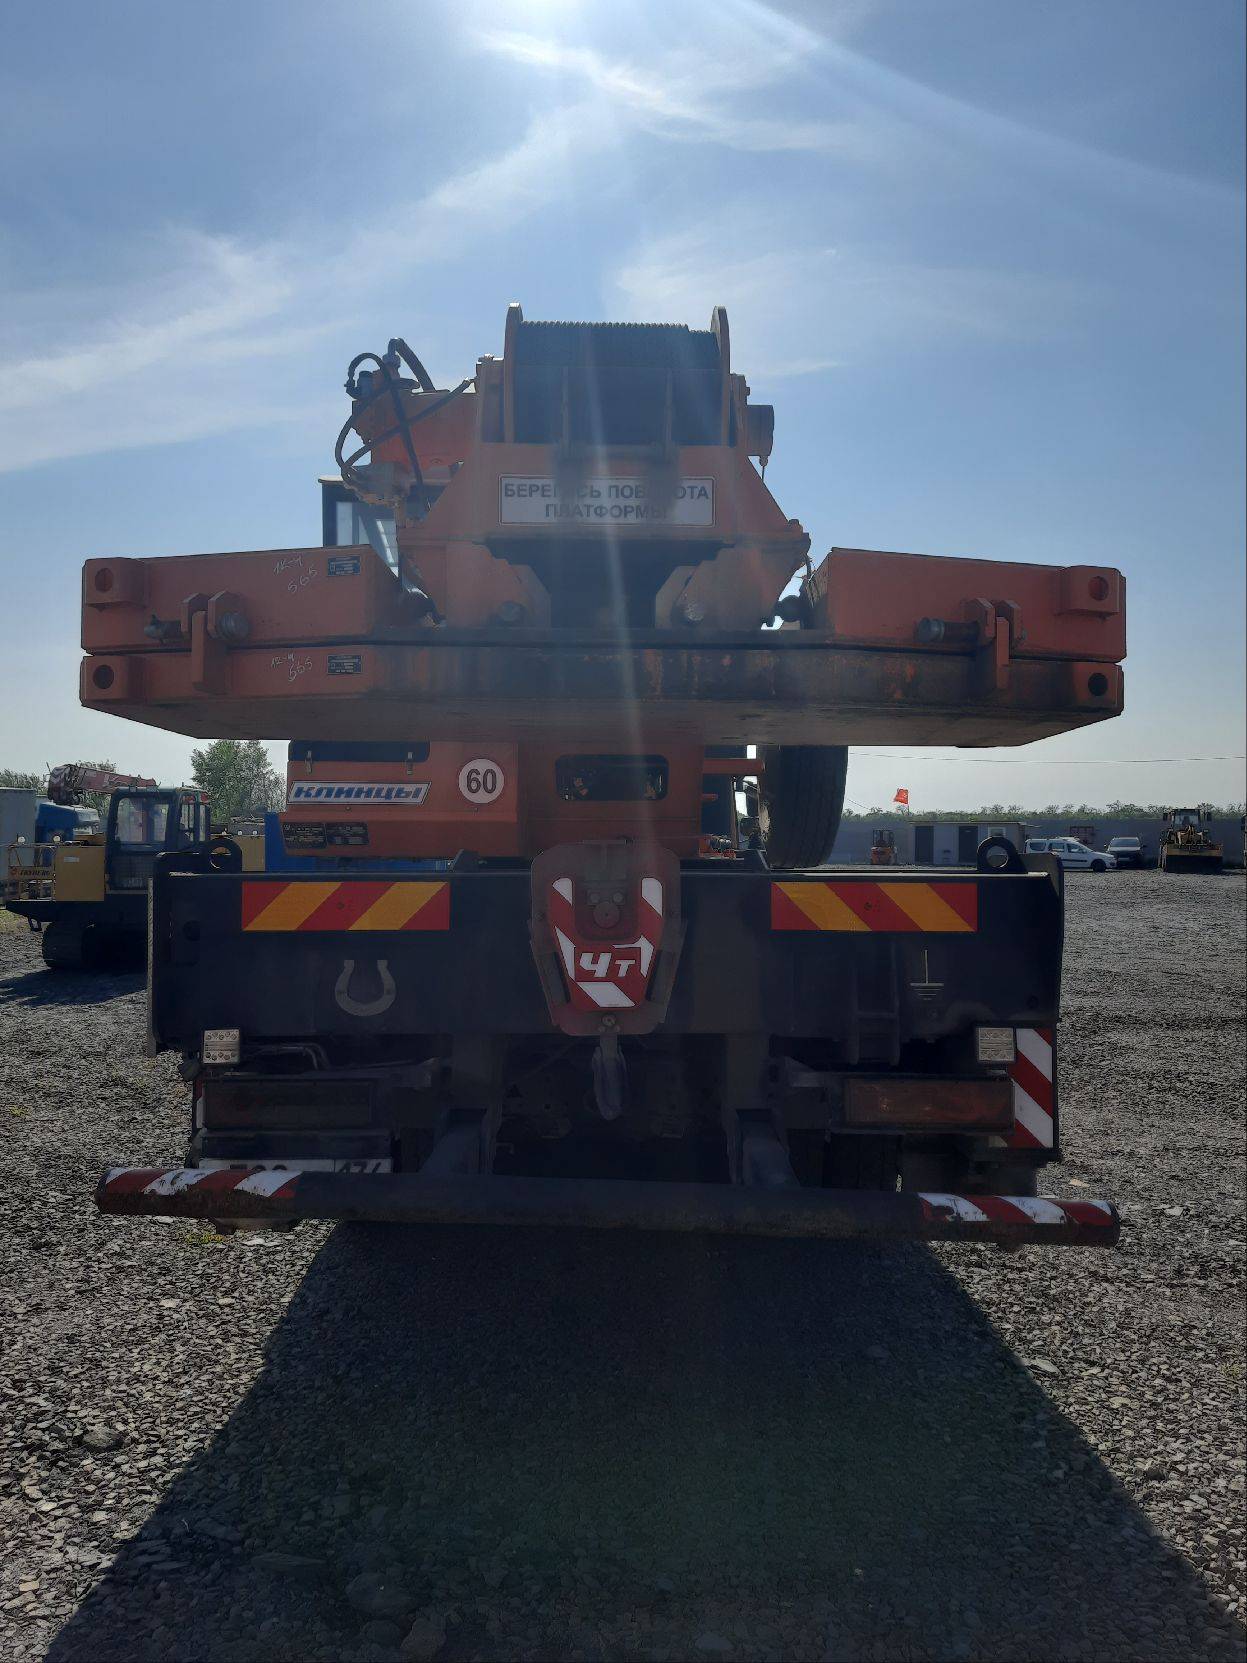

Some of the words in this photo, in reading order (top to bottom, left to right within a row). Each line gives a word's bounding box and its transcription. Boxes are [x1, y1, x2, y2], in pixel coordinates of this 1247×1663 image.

[504, 483, 602, 499] БЕРЕГСЬ
[608, 484, 709, 500] ПОВОТА
[466, 768, 497, 794] 60
[294, 786, 423, 800] КЛИНЦЫ
